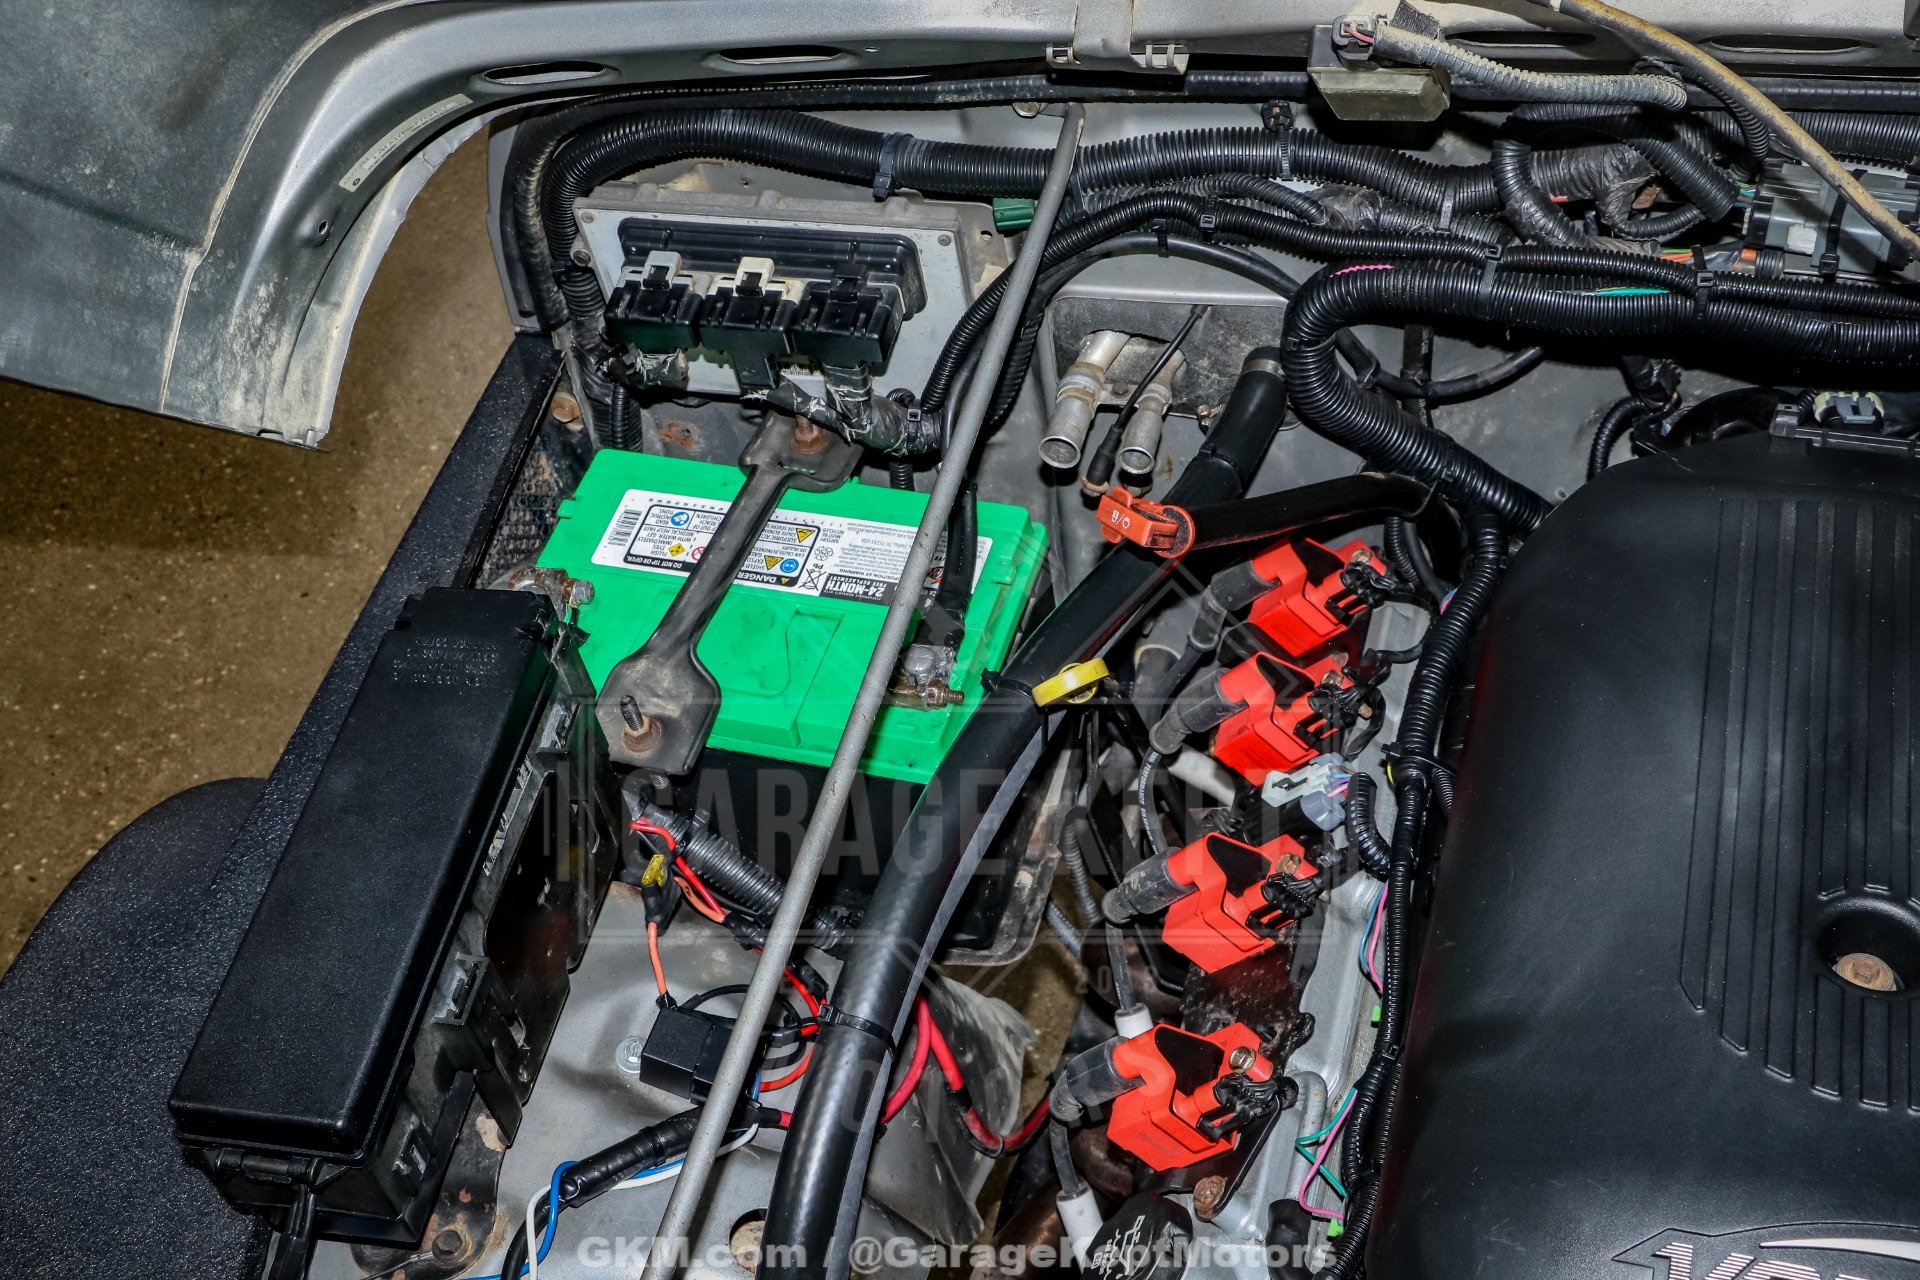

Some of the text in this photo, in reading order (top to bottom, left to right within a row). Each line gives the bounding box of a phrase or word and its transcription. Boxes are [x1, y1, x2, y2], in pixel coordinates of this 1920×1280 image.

[669, 529, 694, 537] MEDICAL
[636, 536, 673, 545] IMMEDIATELY
[744, 562, 765, 570] SHIELD
[736, 571, 777, 582] DANGER
[824, 579, 885, 597] 24-MONTH
[1139, 762, 1152, 806] PERFORMANCE
